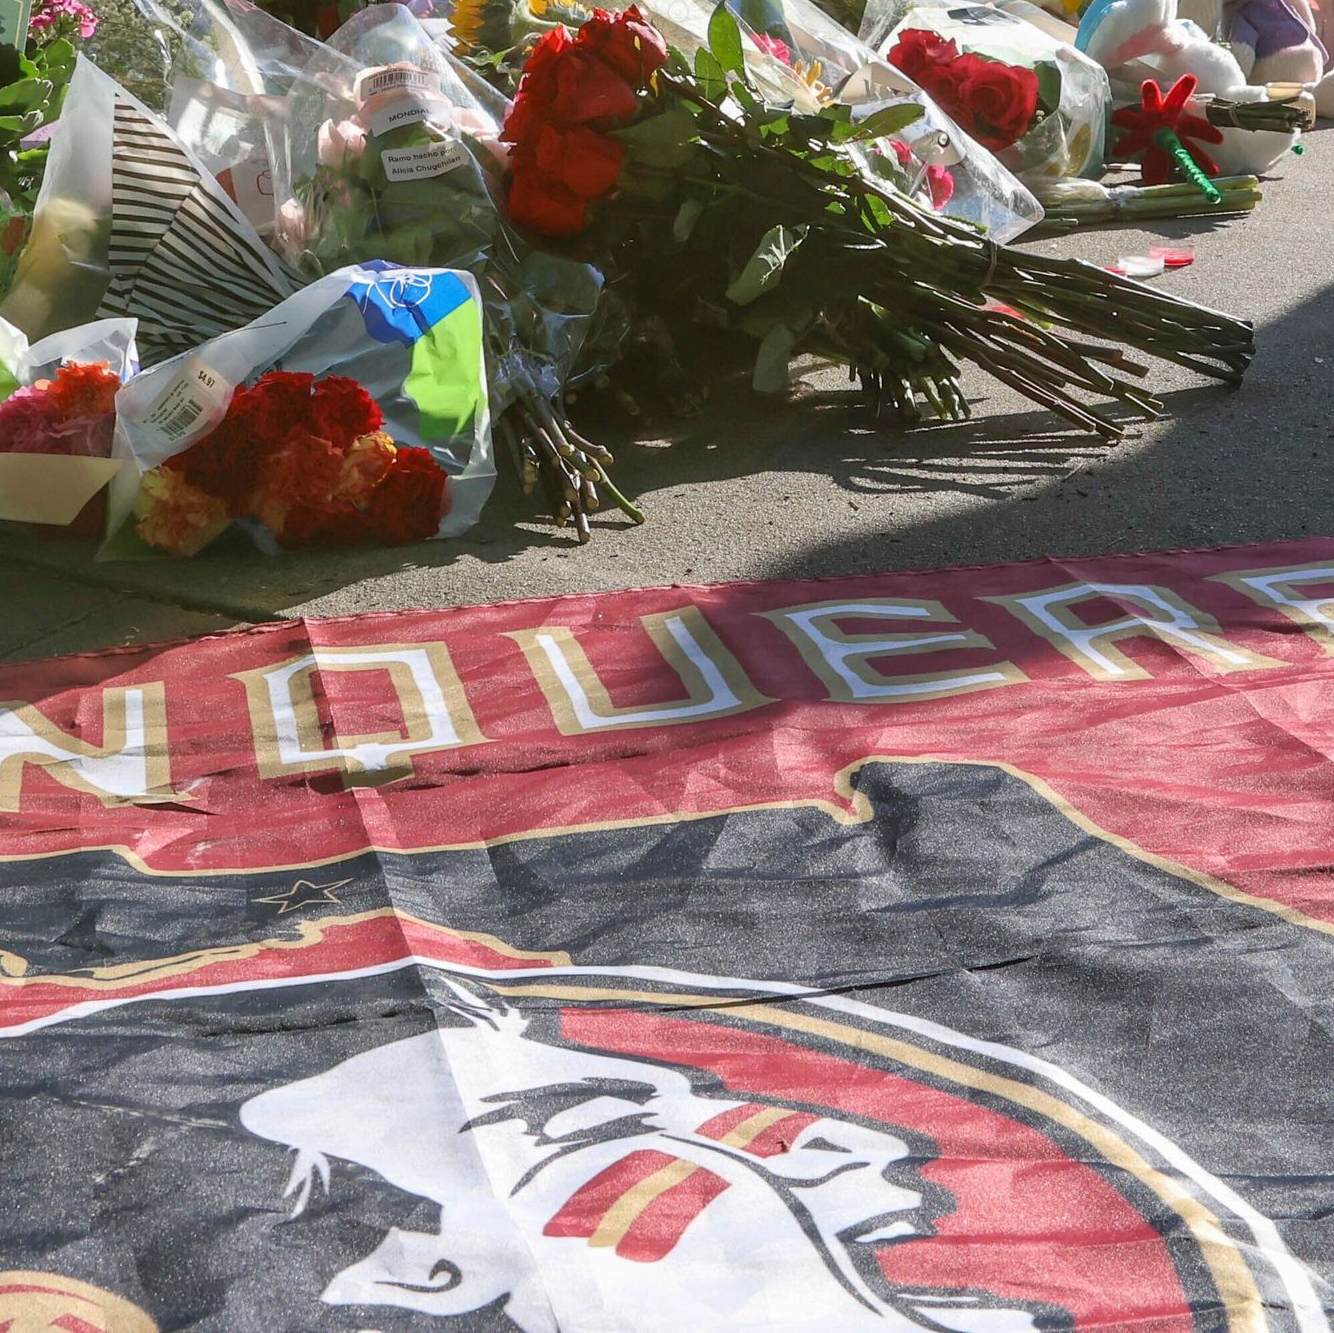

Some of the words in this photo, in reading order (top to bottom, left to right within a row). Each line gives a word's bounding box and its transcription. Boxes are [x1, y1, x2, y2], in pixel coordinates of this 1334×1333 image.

[388, 108, 432, 123] MONDIAL
[387, 154, 411, 163] Ramo
[413, 151, 439, 161] hecho
[197, 370, 216, 389] $4.97
